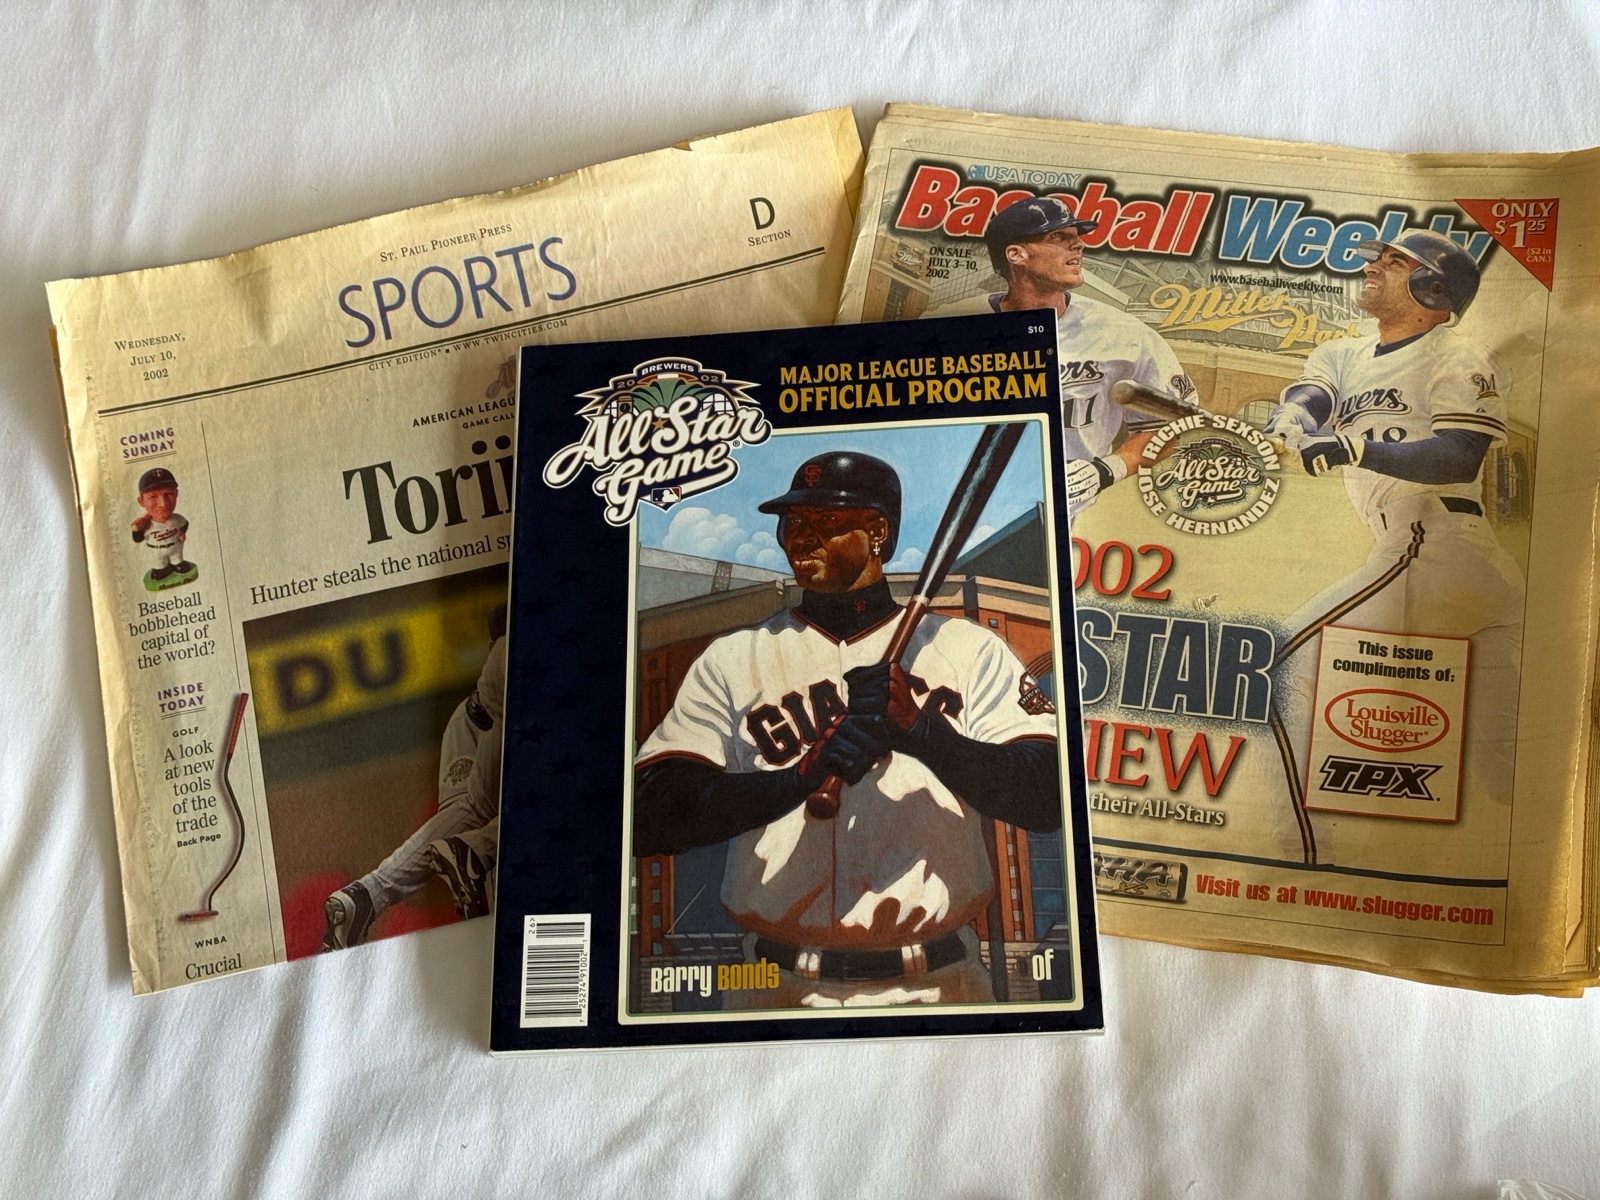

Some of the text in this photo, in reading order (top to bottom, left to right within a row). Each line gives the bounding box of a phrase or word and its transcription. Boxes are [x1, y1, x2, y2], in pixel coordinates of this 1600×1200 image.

[984, 165, 1081, 187] USA TODAY
[749, 197, 775, 230] D
[1491, 202, 1555, 218] ONLY
[380, 223, 512, 262] ST. PAUL PIONEER PRESS
[748, 229, 791, 247] SECTION
[928, 257, 951, 268] JULY
[929, 246, 972, 259] ON SALE
[925, 268, 950, 279] 2002
[1210, 274, 1344, 295] www.baseballweekly.com
[338, 236, 577, 348] SPORTS
[1150, 283, 1291, 328] Miller
[114, 333, 186, 351] WEDNESDAY,
[1027, 325, 1044, 334] $10
[369, 360, 392, 371] CITY
[453, 319, 568, 352] WWW.TWINCITIES.COM
[130, 350, 176, 367] JULY 10,
[641, 362, 695, 376] BREWERS
[780, 350, 1046, 385] MAJOR LEAGUE BASEBALL
[143, 368, 169, 381] 2002
[617, 374, 719, 388] 20 02
[778, 372, 1047, 413] OFFICIAL PROGRAM
[412, 397, 515, 427] AMERICAN LEAGU
[462, 412, 515, 429] GAME CALL
[120, 427, 175, 446] COMING
[544, 396, 766, 485] All Star
[1142, 414, 1280, 471] RICHIE SEXSON
[123, 440, 175, 459] SUNDAY
[594, 442, 730, 522] Game
[1155, 456, 1261, 487] All Star
[342, 435, 514, 545] Torii
[1138, 465, 1281, 535] JOSE HERNANDEZ
[1178, 479, 1241, 508] Game
[250, 575, 318, 605] Hunter
[324, 562, 377, 589] steals
[381, 556, 412, 575] the
[416, 535, 492, 568] national
[138, 591, 202, 617] Baseball
[129, 606, 216, 637] bobblehead
[141, 624, 209, 651] capital of
[137, 640, 215, 669] the world?
[1358, 640, 1433, 661] This issue
[1075, 606, 1275, 724] STAR
[1333, 658, 1455, 682] compliments of:
[158, 682, 204, 700] INSIDE
[159, 695, 204, 713] TODAY
[1345, 698, 1439, 727] Louisville
[172, 726, 199, 738] GOLF
[1350, 718, 1424, 746] Slugger
[163, 739, 214, 763] A look
[165, 759, 215, 780] at new
[1319, 755, 1444, 801] TPX
[173, 776, 211, 797] tools
[172, 795, 217, 815] of the
[1090, 793, 1225, 826] their All-Stars
[175, 812, 218, 834] trade
[177, 833, 221, 848] Back Page
[1196, 874, 1494, 926] Visit us at www.slugger.com
[195, 935, 227, 948] WNBA
[185, 953, 243, 980] Crucial
[650, 957, 780, 998] Barry Bonds
